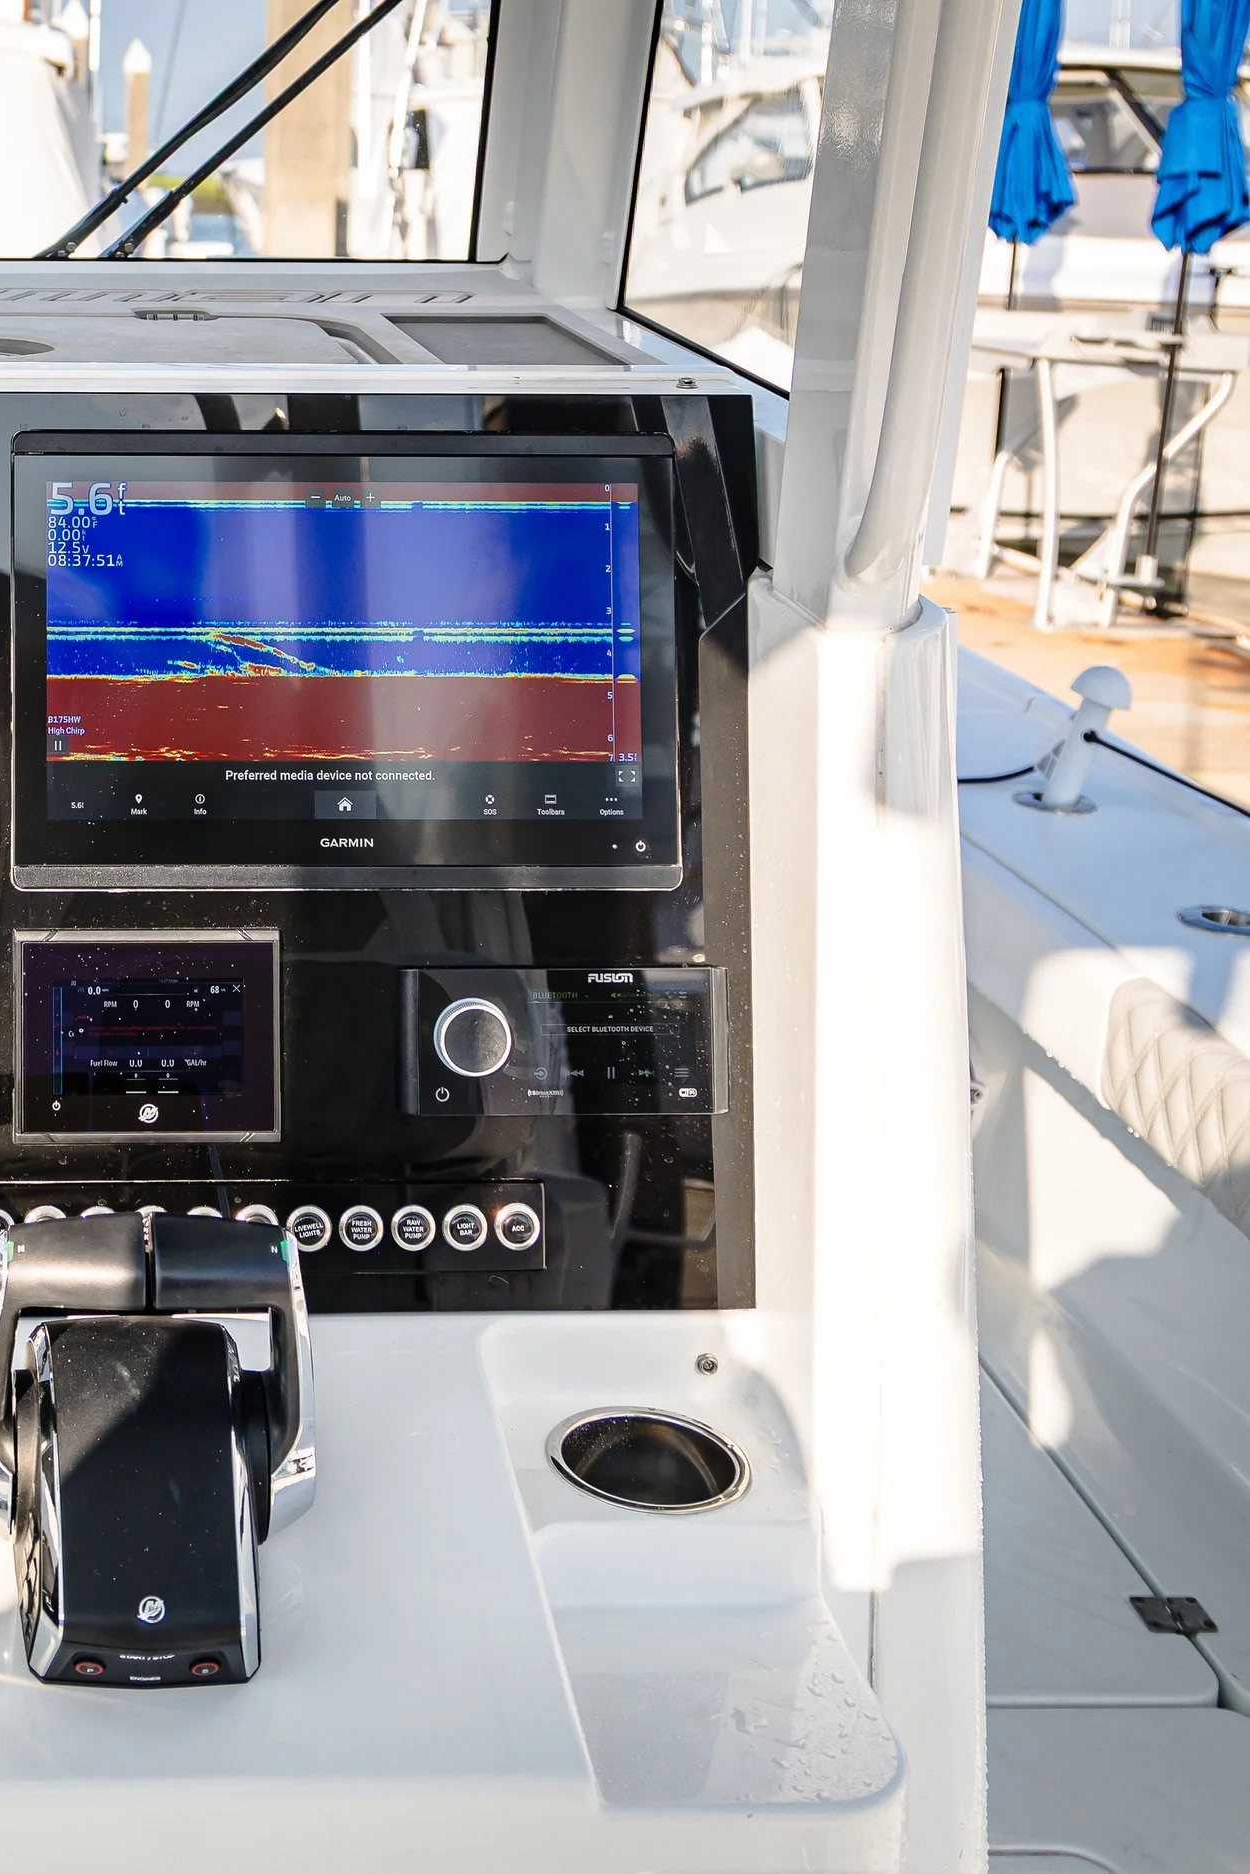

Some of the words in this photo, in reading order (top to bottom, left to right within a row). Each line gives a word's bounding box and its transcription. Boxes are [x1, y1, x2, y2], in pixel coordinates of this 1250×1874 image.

[334, 494, 352, 502] Auto
[47, 726, 65, 736] High
[66, 726, 85, 736] Chirp
[225, 770, 277, 781] Preferred
[280, 770, 314, 781] media
[316, 770, 352, 781] device
[355, 770, 373, 781] not
[375, 770, 436, 782] connected.
[483, 808, 497, 816] SOS
[537, 808, 565, 816] Toolbars
[599, 808, 624, 817] Options
[320, 838, 374, 848] GARMIN
[87, 986, 101, 995] 0.0
[210, 985, 220, 994] 68
[532, 991, 578, 999] BLUETOOTH
[186, 1000, 200, 1008] RPM
[90, 1059, 103, 1067] Fuel
[103, 1059, 118, 1067] Flow
[294, 1222, 323, 1232] LIVEWELL
[299, 1230, 321, 1238] LIGHTS
[17, 1244, 25, 1252] N
[271, 1246, 278, 1254] N
